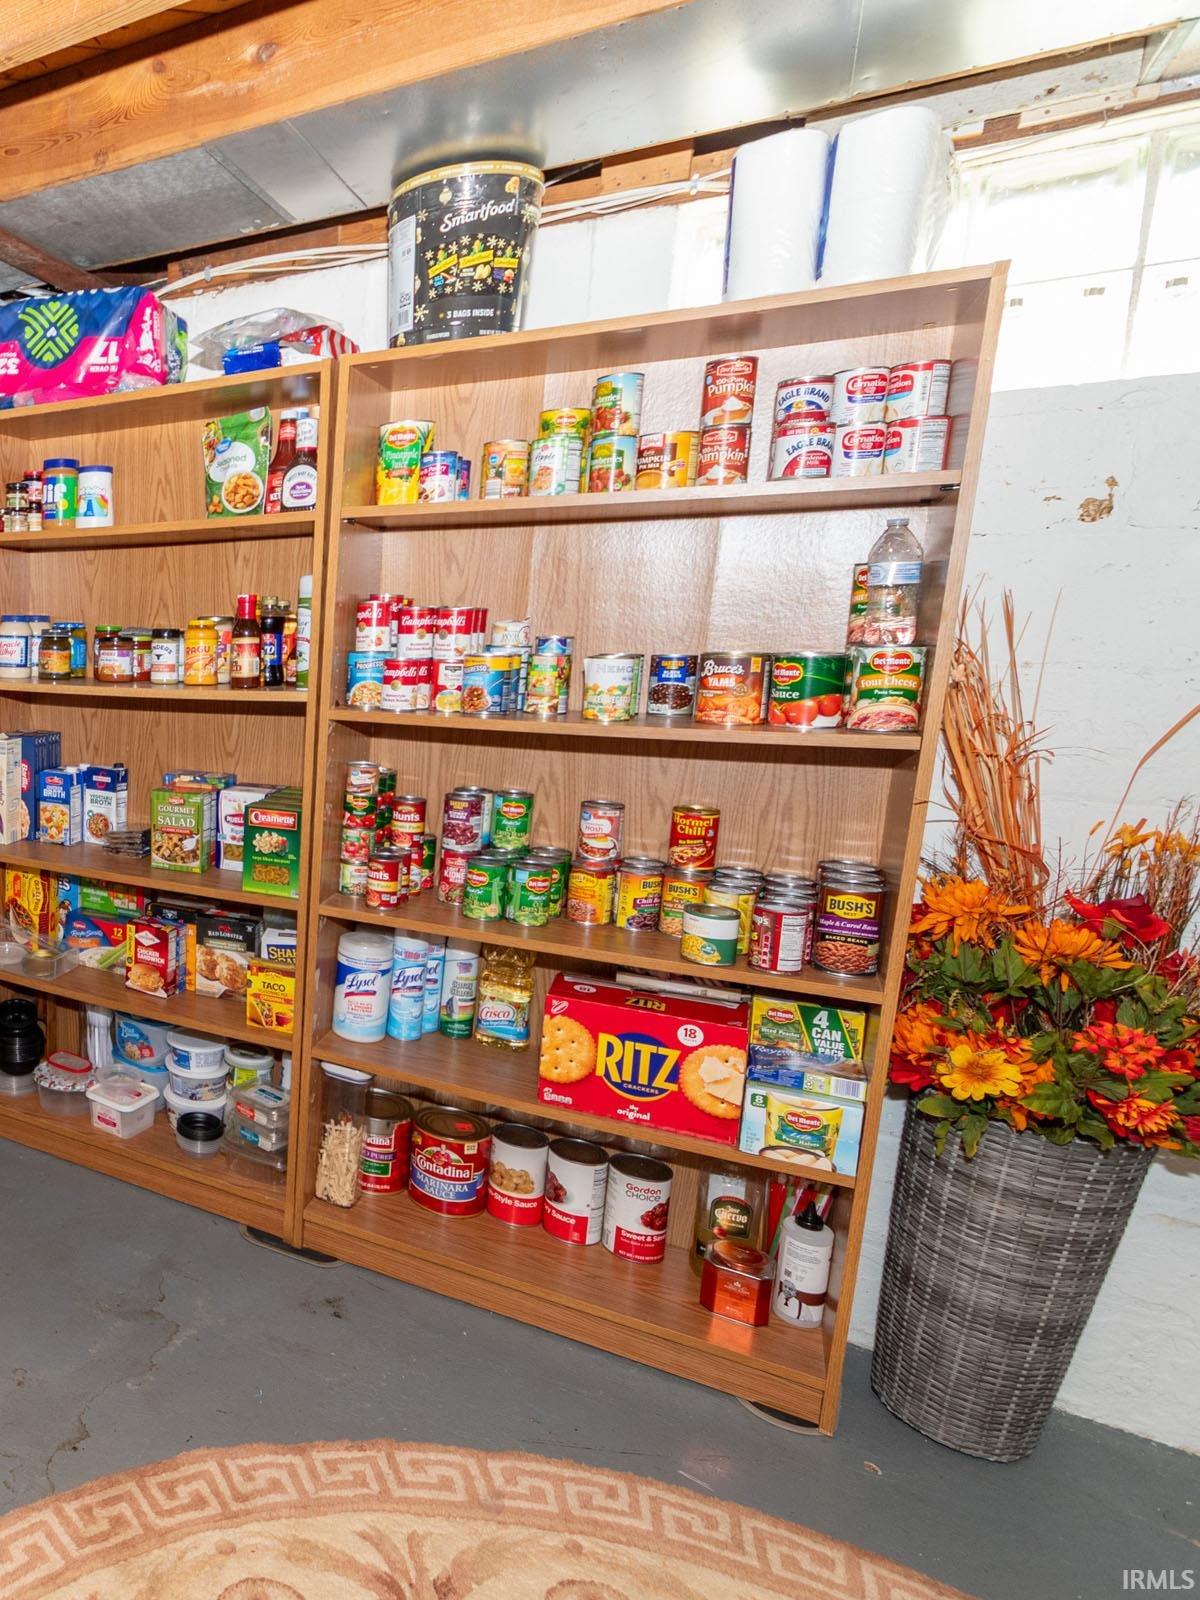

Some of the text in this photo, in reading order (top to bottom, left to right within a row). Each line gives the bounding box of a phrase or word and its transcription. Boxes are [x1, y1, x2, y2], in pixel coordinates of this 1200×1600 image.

[440, 198, 516, 233] Smartfood
[446, 307, 495, 319] 3 BAGS INSIDE
[779, 386, 831, 407] EAGLE BRAND
[397, 431, 417, 441] Monte
[385, 448, 418, 459] Pineapple
[0, 648, 17, 658] Whip
[874, 657, 911, 666] Del Monte
[701, 659, 745, 678] Bruce's
[781, 669, 801, 677] Monte
[706, 677, 737, 688] YAMS
[860, 676, 918, 689] Four Cheese
[771, 689, 801, 700] Sauce
[43, 788, 66, 799] BROTH
[90, 798, 112, 806] BROTH
[157, 804, 197, 816] GOURMET
[393, 810, 421, 822] Hunt's
[157, 815, 196, 828] SALAD
[251, 811, 296, 826] Creamette
[674, 812, 715, 828] Hormel
[584, 825, 604, 834] Hash
[676, 824, 706, 837] Chili
[668, 884, 699, 897] BUSH'S
[829, 898, 875, 916] BUSH'S
[820, 918, 879, 932] Maple & Cured Bacon
[112, 927, 124, 937] 12
[219, 930, 244, 941] LOBSTER
[825, 933, 869, 945] BAKED BEANS
[136, 947, 160, 958] CHICKEN
[136, 953, 165, 965] SANDWICH
[346, 974, 378, 991] Lysol
[393, 969, 426, 988] Lysol
[261, 980, 286, 992] TACO
[625, 996, 667, 1012] RITZ
[480, 1006, 511, 1019] Crisco
[767, 1009, 795, 1020] Del Monte
[813, 1010, 830, 1030] 4
[682, 1027, 698, 1040] 18
[778, 1029, 801, 1039] Peaches
[811, 1027, 842, 1043] CAN
[814, 1038, 845, 1051] VALUE
[817, 1047, 845, 1058] PACK
[595, 1032, 682, 1092] RITZ
[622, 1082, 660, 1096] CRACKERS
[755, 1094, 764, 1104] 8
[628, 1104, 640, 1112] the
[616, 1108, 651, 1122] original
[786, 1114, 822, 1127] Del Monte
[781, 1134, 820, 1148] Pear Halves
[416, 1154, 471, 1179] Contadina
[415, 1170, 470, 1193] MARINARA
[424, 1184, 457, 1200] SAUCE
[625, 1182, 662, 1195] Gordon
[513, 1199, 538, 1209] Sauce
[551, 1209, 576, 1225] Sauce
[714, 1207, 749, 1224] Cuervo
[621, 1229, 646, 1242] Sweet
